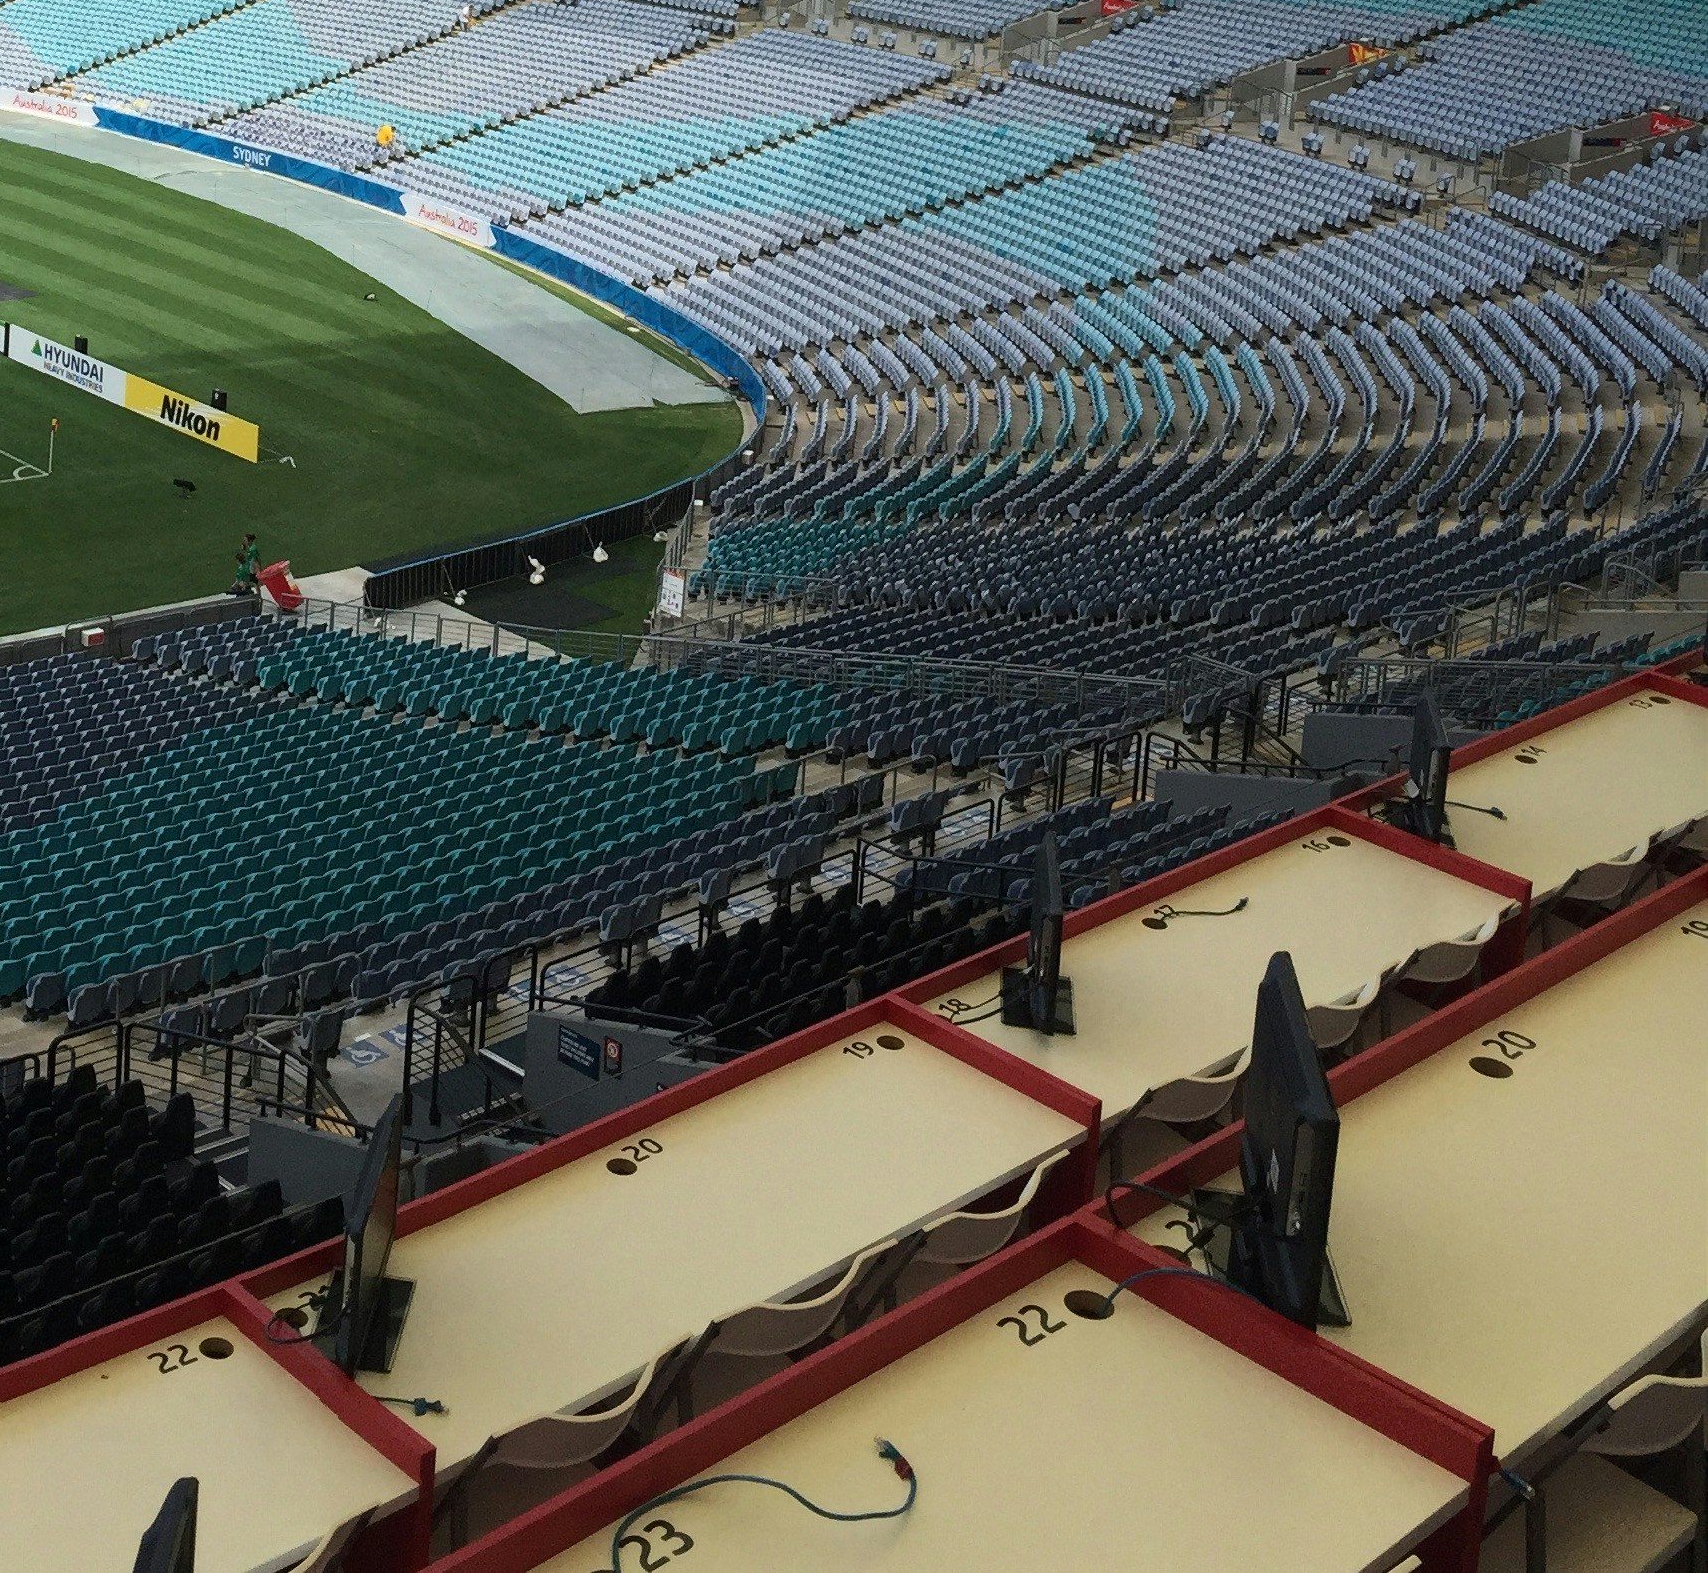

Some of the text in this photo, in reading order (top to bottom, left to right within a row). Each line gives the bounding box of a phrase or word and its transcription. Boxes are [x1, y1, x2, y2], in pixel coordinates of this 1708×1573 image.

[13, 94, 77, 118] Australia 2015
[233, 146, 271, 166] SYDNEY
[44, 343, 104, 383] HYUNDAI
[161, 394, 220, 441] Nikon
[1629, 699, 1653, 710] 13
[1521, 745, 1547, 757] 14
[1301, 839, 1330, 853] 16
[843, 1041, 874, 1060] 19
[1482, 1031, 1537, 1060] 20
[621, 1138, 664, 1162] 20
[996, 1304, 1068, 1347] 22
[147, 1344, 199, 1374] 22
[618, 1519, 695, 1573] 23
